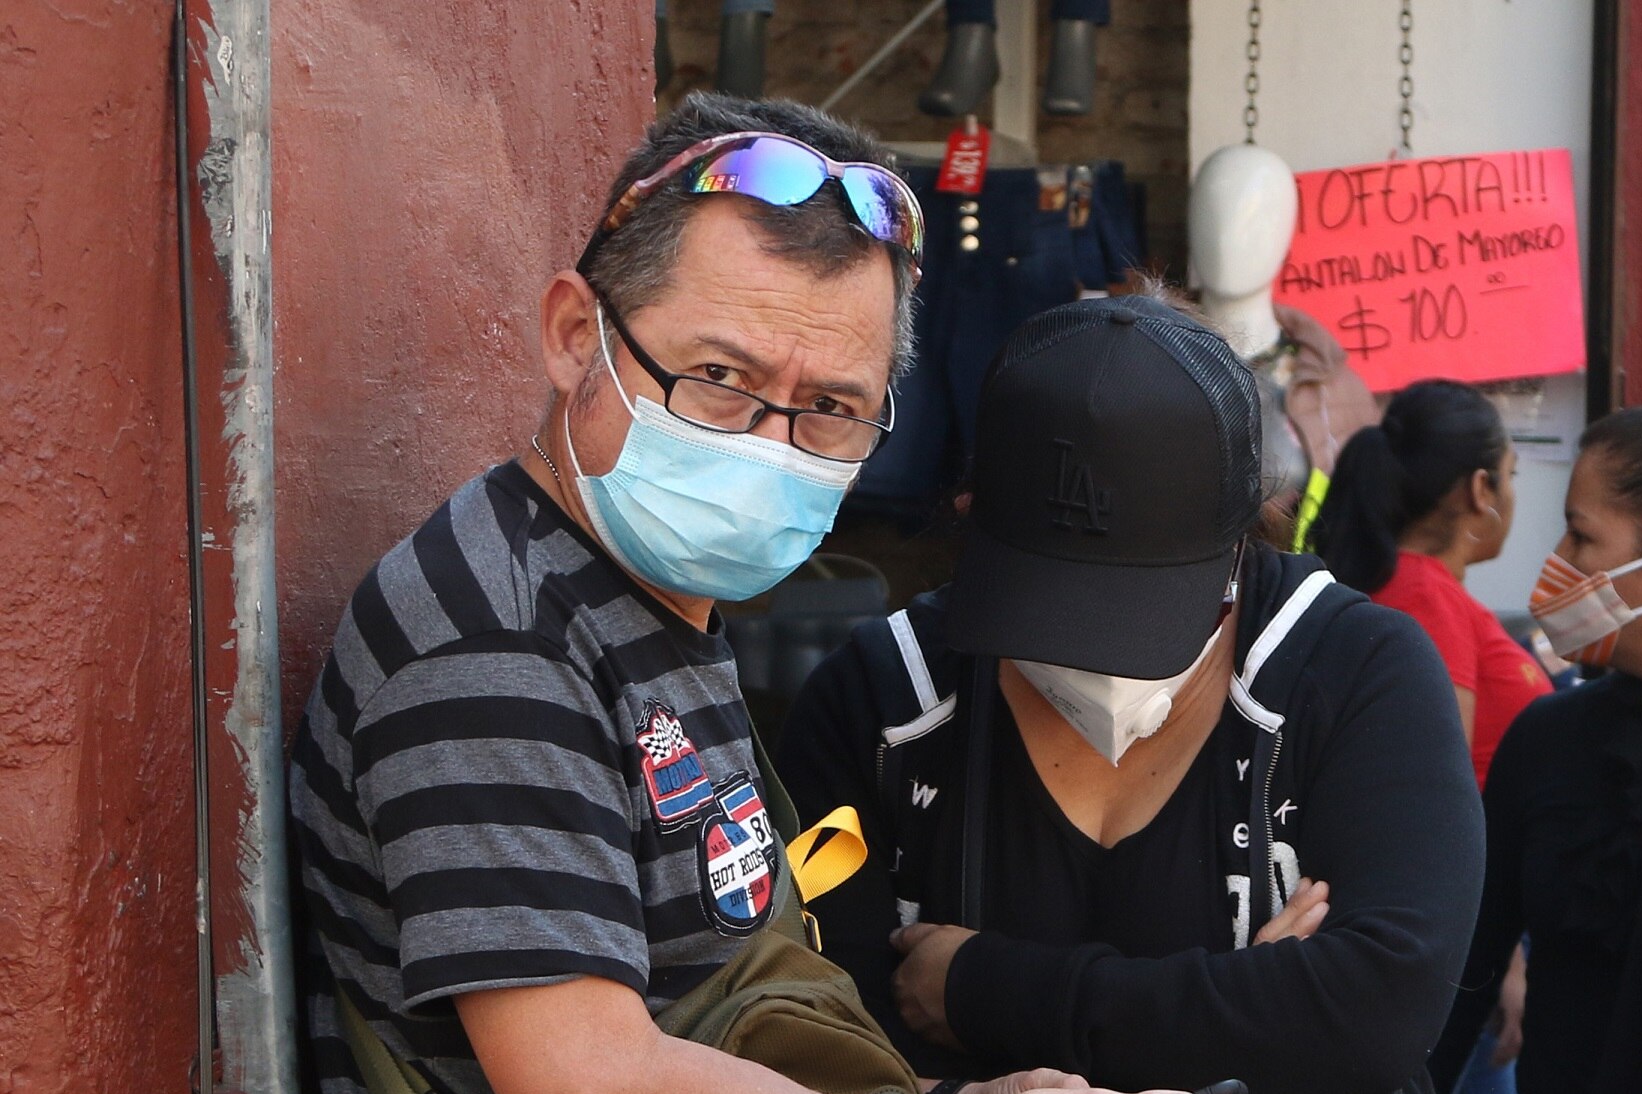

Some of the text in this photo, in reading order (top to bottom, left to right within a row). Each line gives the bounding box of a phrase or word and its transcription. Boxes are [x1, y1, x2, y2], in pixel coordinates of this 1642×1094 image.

[1280, 248, 1406, 294] ANTALON
[1412, 234, 1449, 274] DE
[710, 847, 765, 892] HOT RODS
[729, 880, 766, 908] DIVISION
